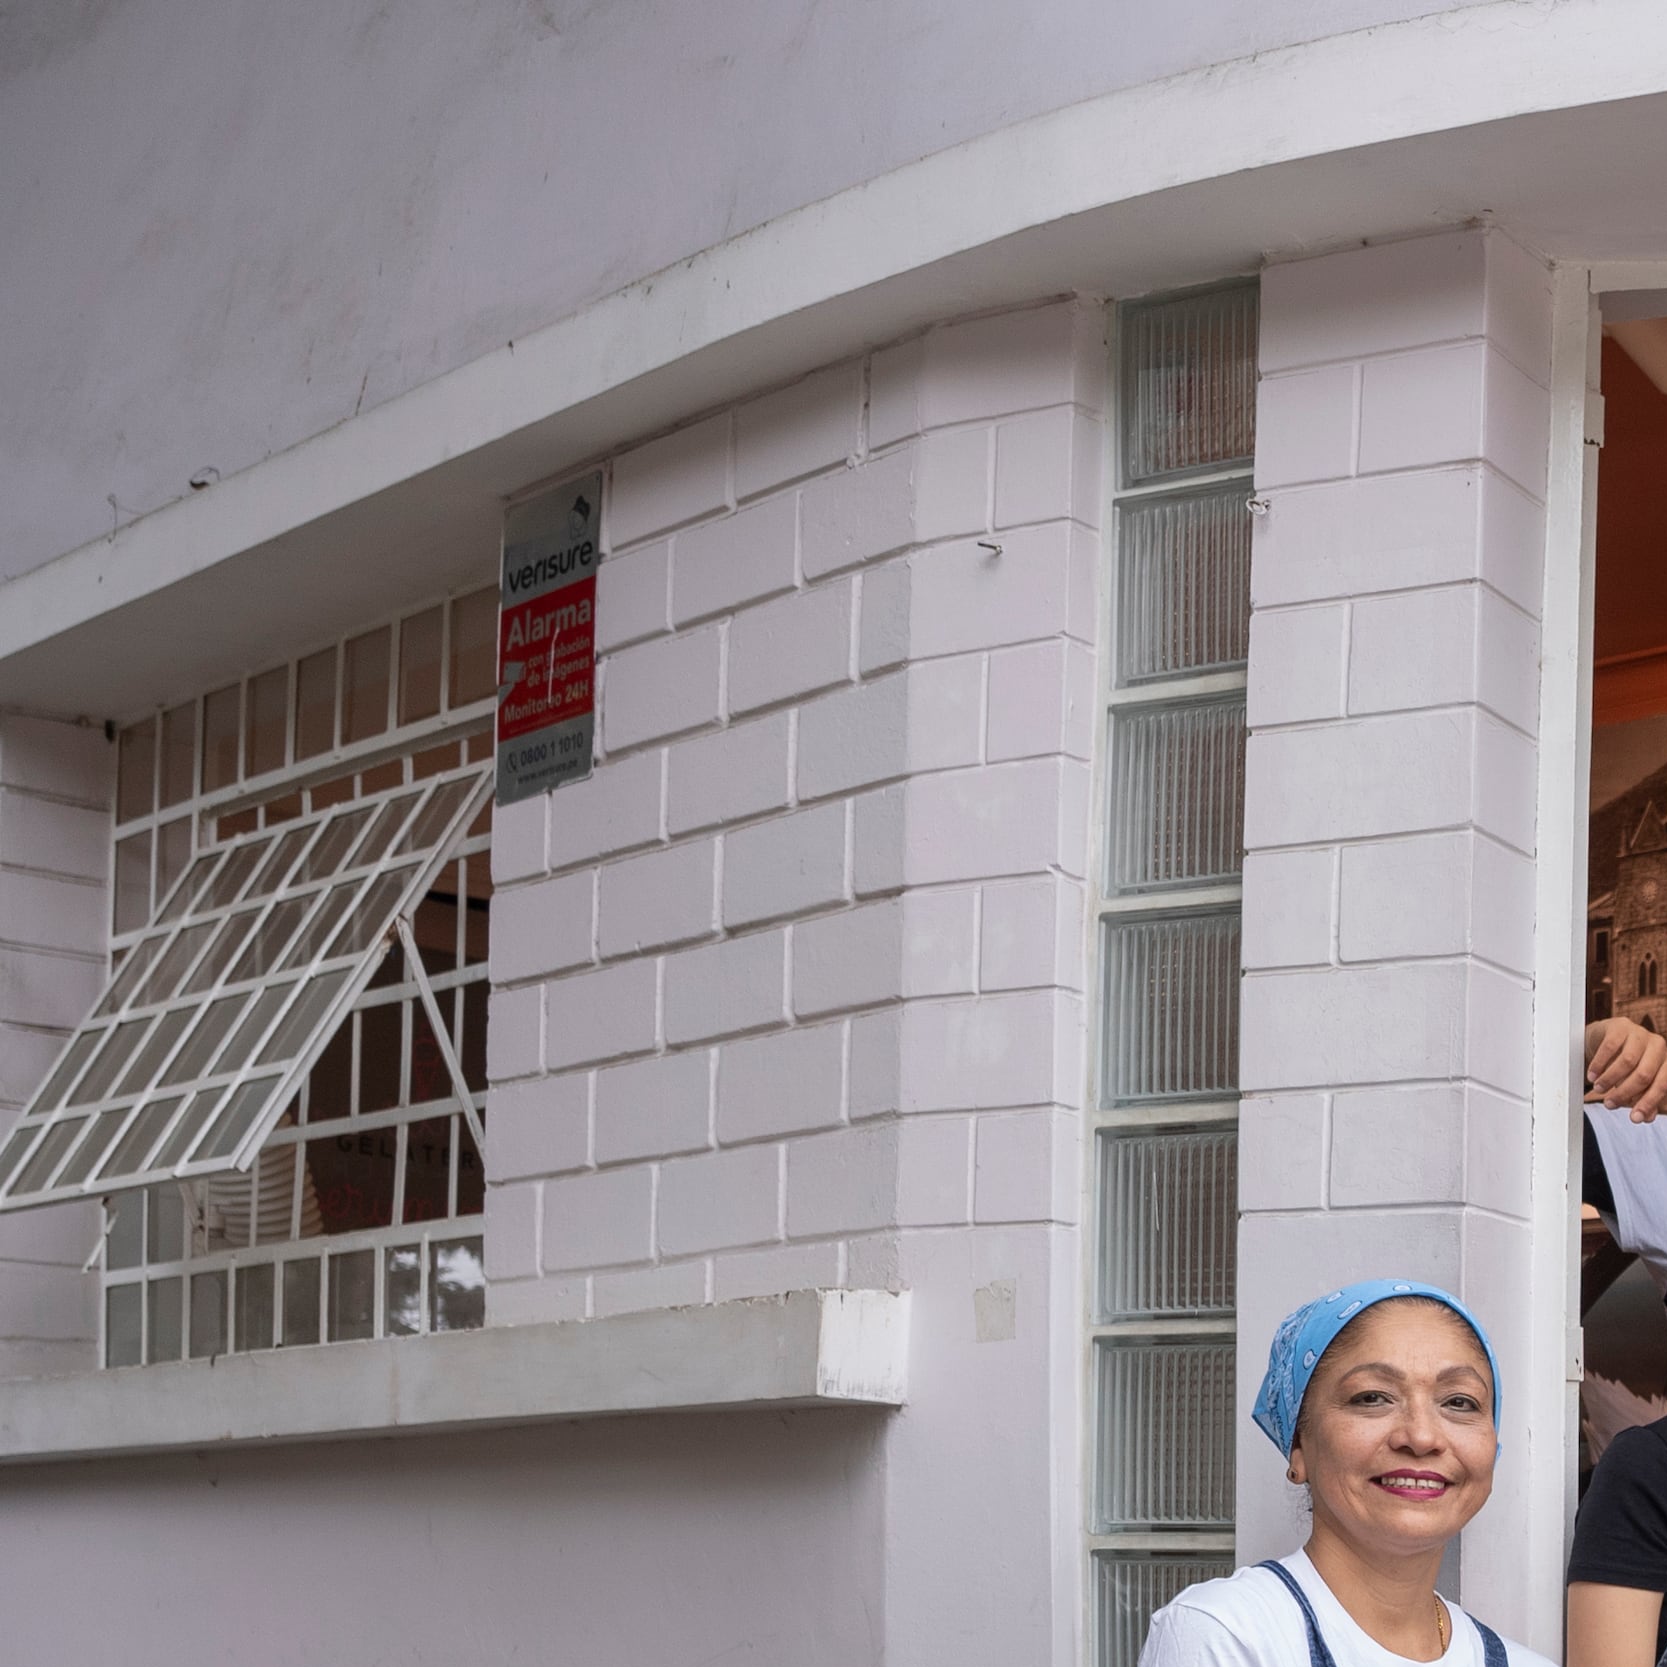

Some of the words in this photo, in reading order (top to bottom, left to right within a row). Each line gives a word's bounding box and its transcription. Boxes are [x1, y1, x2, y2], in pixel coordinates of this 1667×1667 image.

[508, 541, 593, 593] verisure
[505, 598, 592, 652] Alarma
[565, 680, 589, 704] 24H
[520, 743, 548, 767] 0800
[559, 732, 584, 755] 1010
